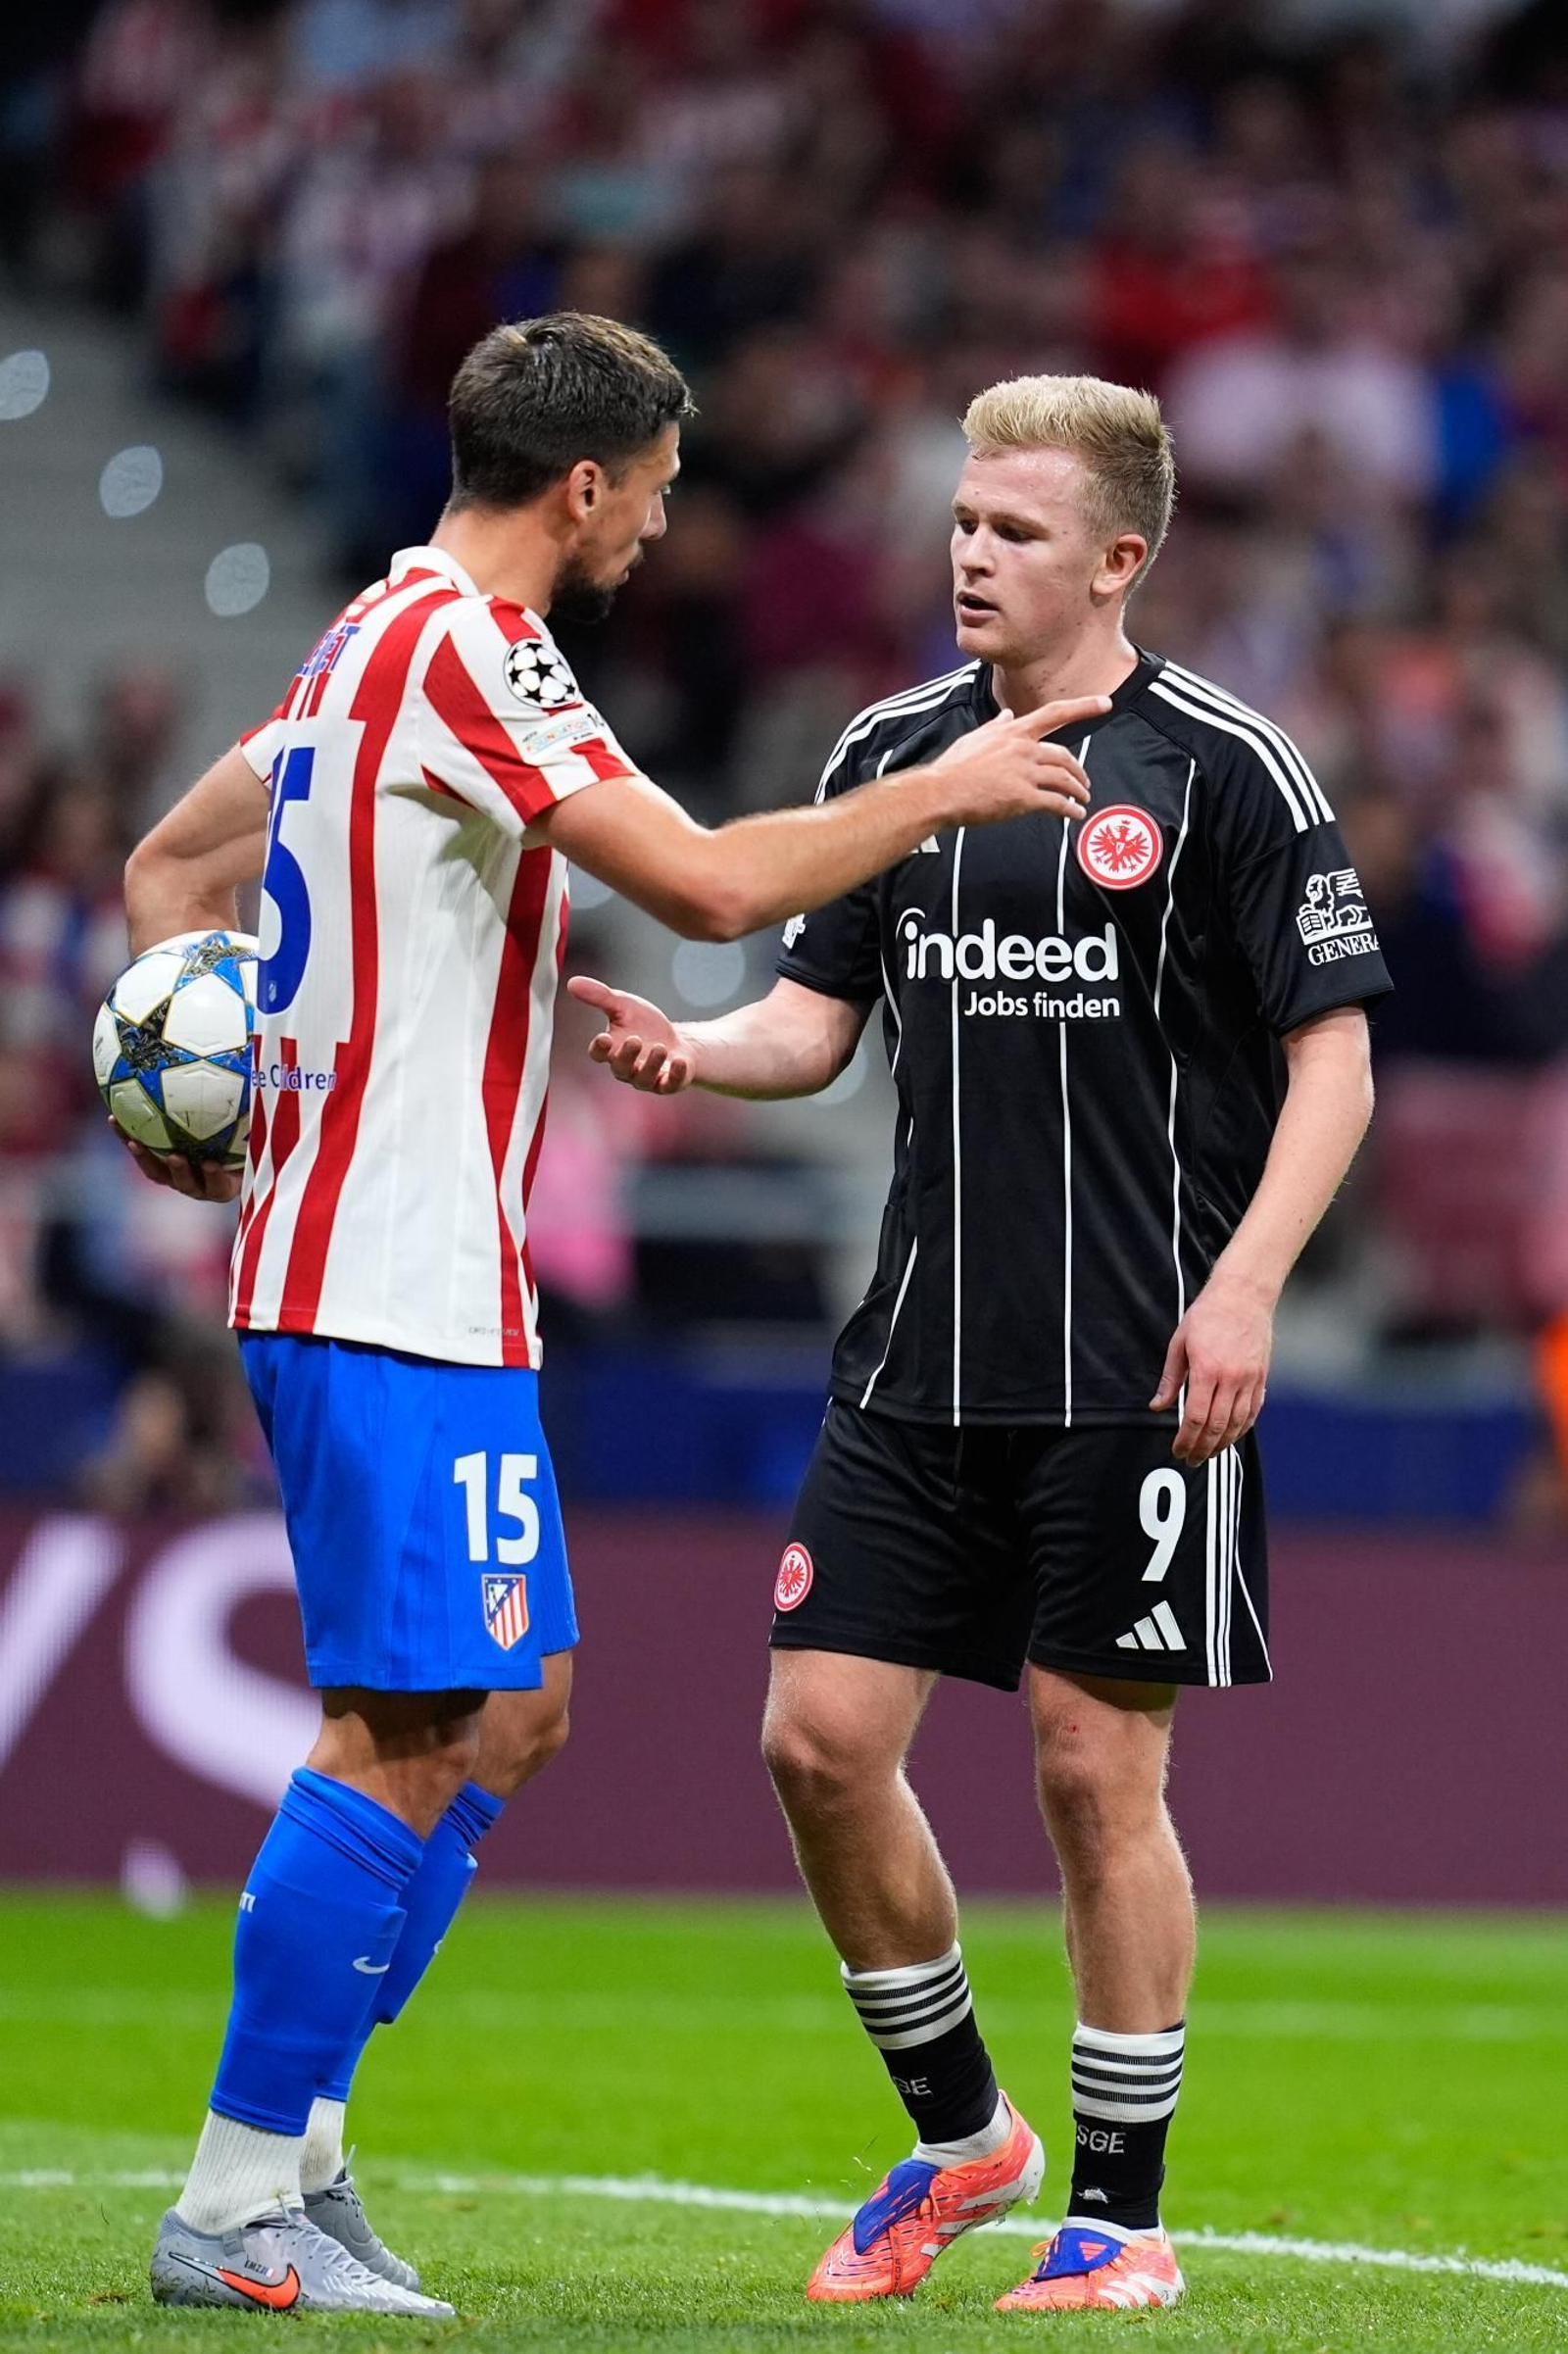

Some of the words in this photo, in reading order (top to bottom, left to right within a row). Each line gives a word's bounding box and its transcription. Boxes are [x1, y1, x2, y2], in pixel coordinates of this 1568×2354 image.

[895, 907, 1119, 982] indeed
[964, 991, 1028, 1016] Jobs
[1033, 992, 1120, 1018] finden
[453, 1450, 540, 1565] 15
[1139, 1467, 1187, 1583] 9
[1076, 2124, 1126, 2154] SGE
